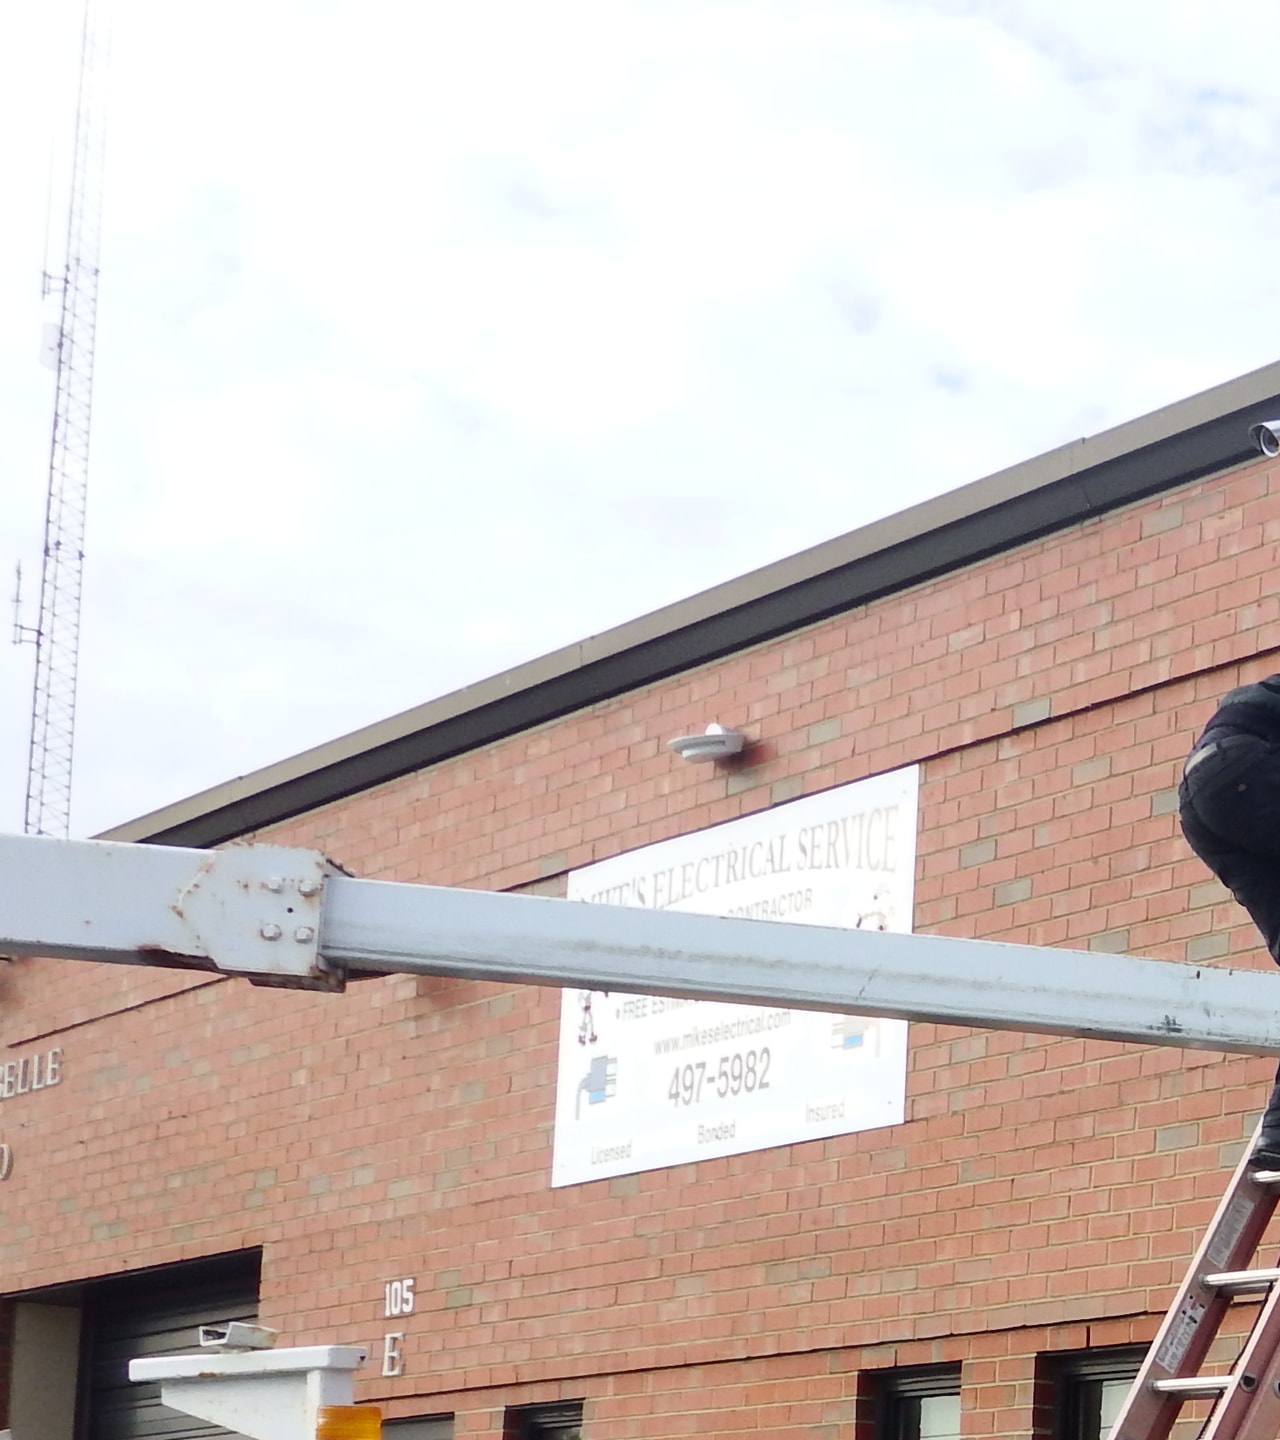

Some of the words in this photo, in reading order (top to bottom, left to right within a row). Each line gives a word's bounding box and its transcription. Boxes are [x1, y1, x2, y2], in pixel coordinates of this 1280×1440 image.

[652, 834, 791, 910] ELECTRICAL
[798, 805, 899, 873] SERVICE
[623, 997, 648, 1022] FREE
[654, 1009, 791, 1056] www.mikeselectrical.com
[668, 1047, 770, 1108] 497-5982
[591, 1140, 632, 1166] Licensed
[698, 1119, 736, 1144] Bonded
[806, 1099, 845, 1124] Insured
[385, 1279, 413, 1317] 105
[382, 1332, 404, 1376] E
